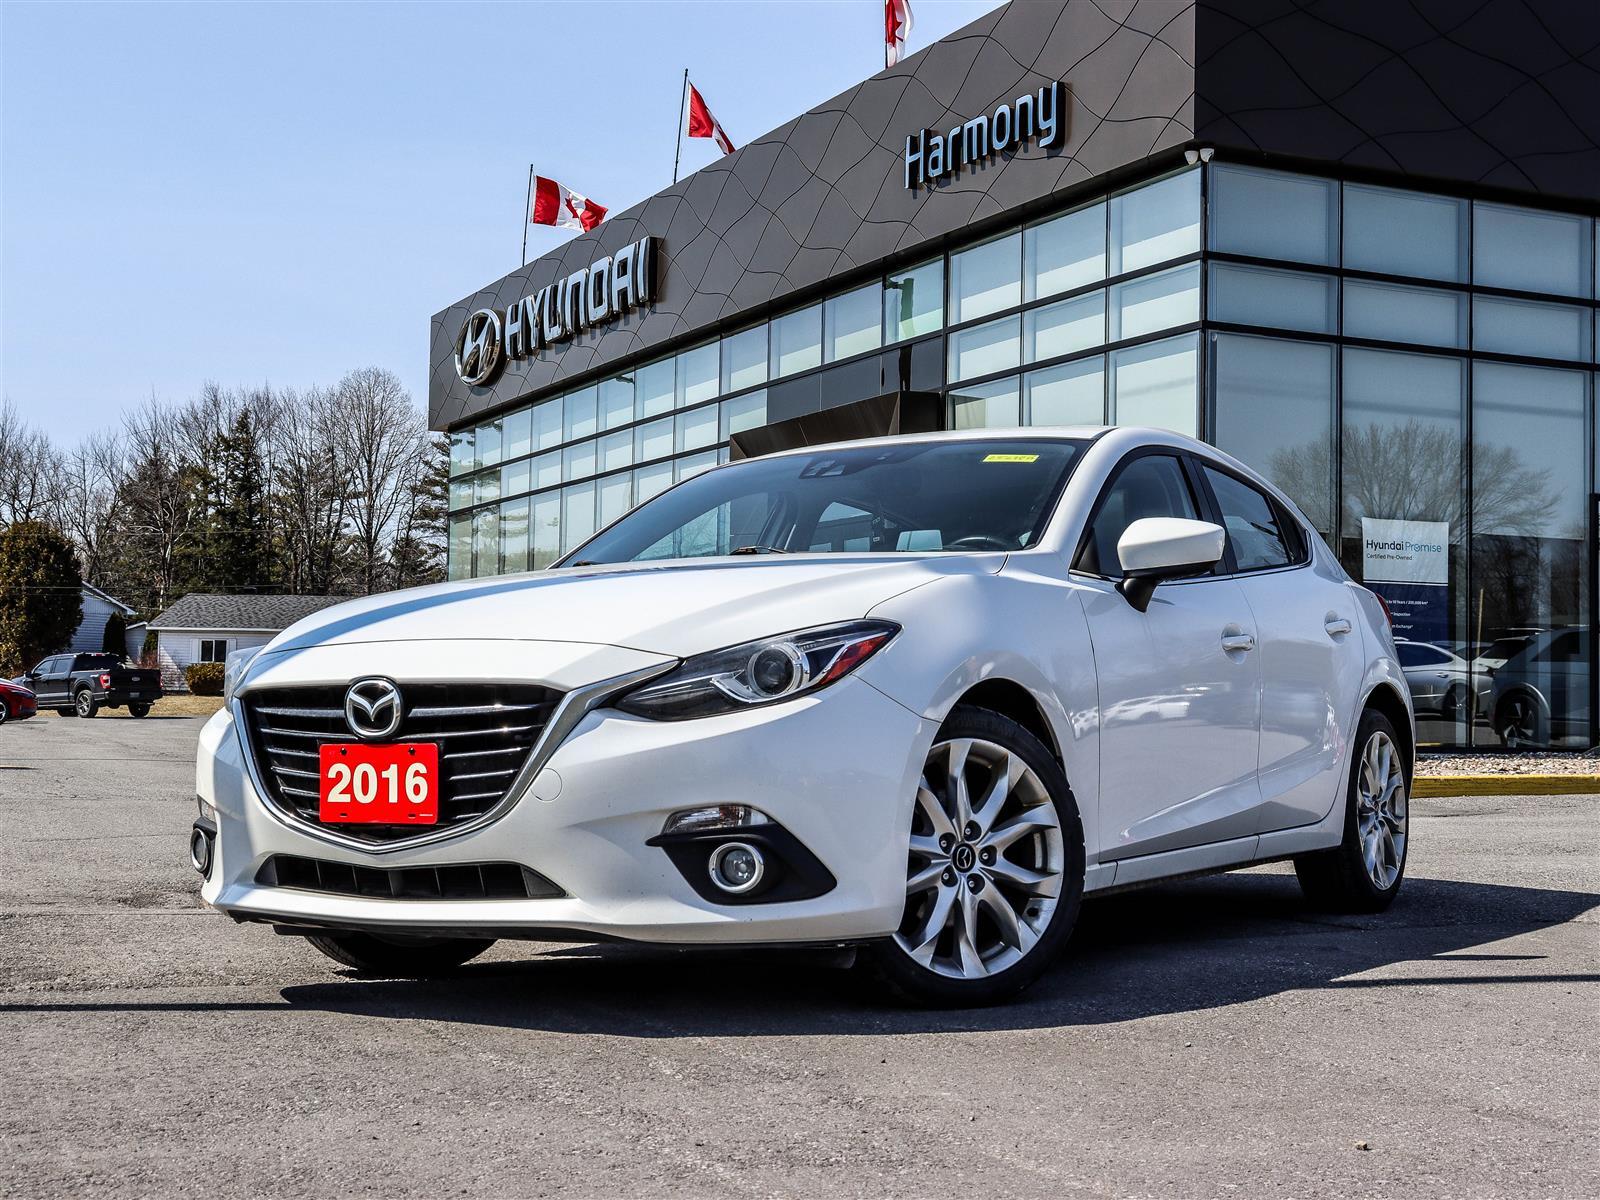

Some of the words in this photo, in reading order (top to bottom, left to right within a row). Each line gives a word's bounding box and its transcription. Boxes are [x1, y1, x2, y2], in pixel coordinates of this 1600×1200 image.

[904, 80, 1060, 189] Harmony
[504, 235, 654, 360] HYUNDAI
[1366, 539, 1404, 551] Hyundai
[1405, 541, 1442, 553] Promise
[327, 762, 428, 804] 2016
